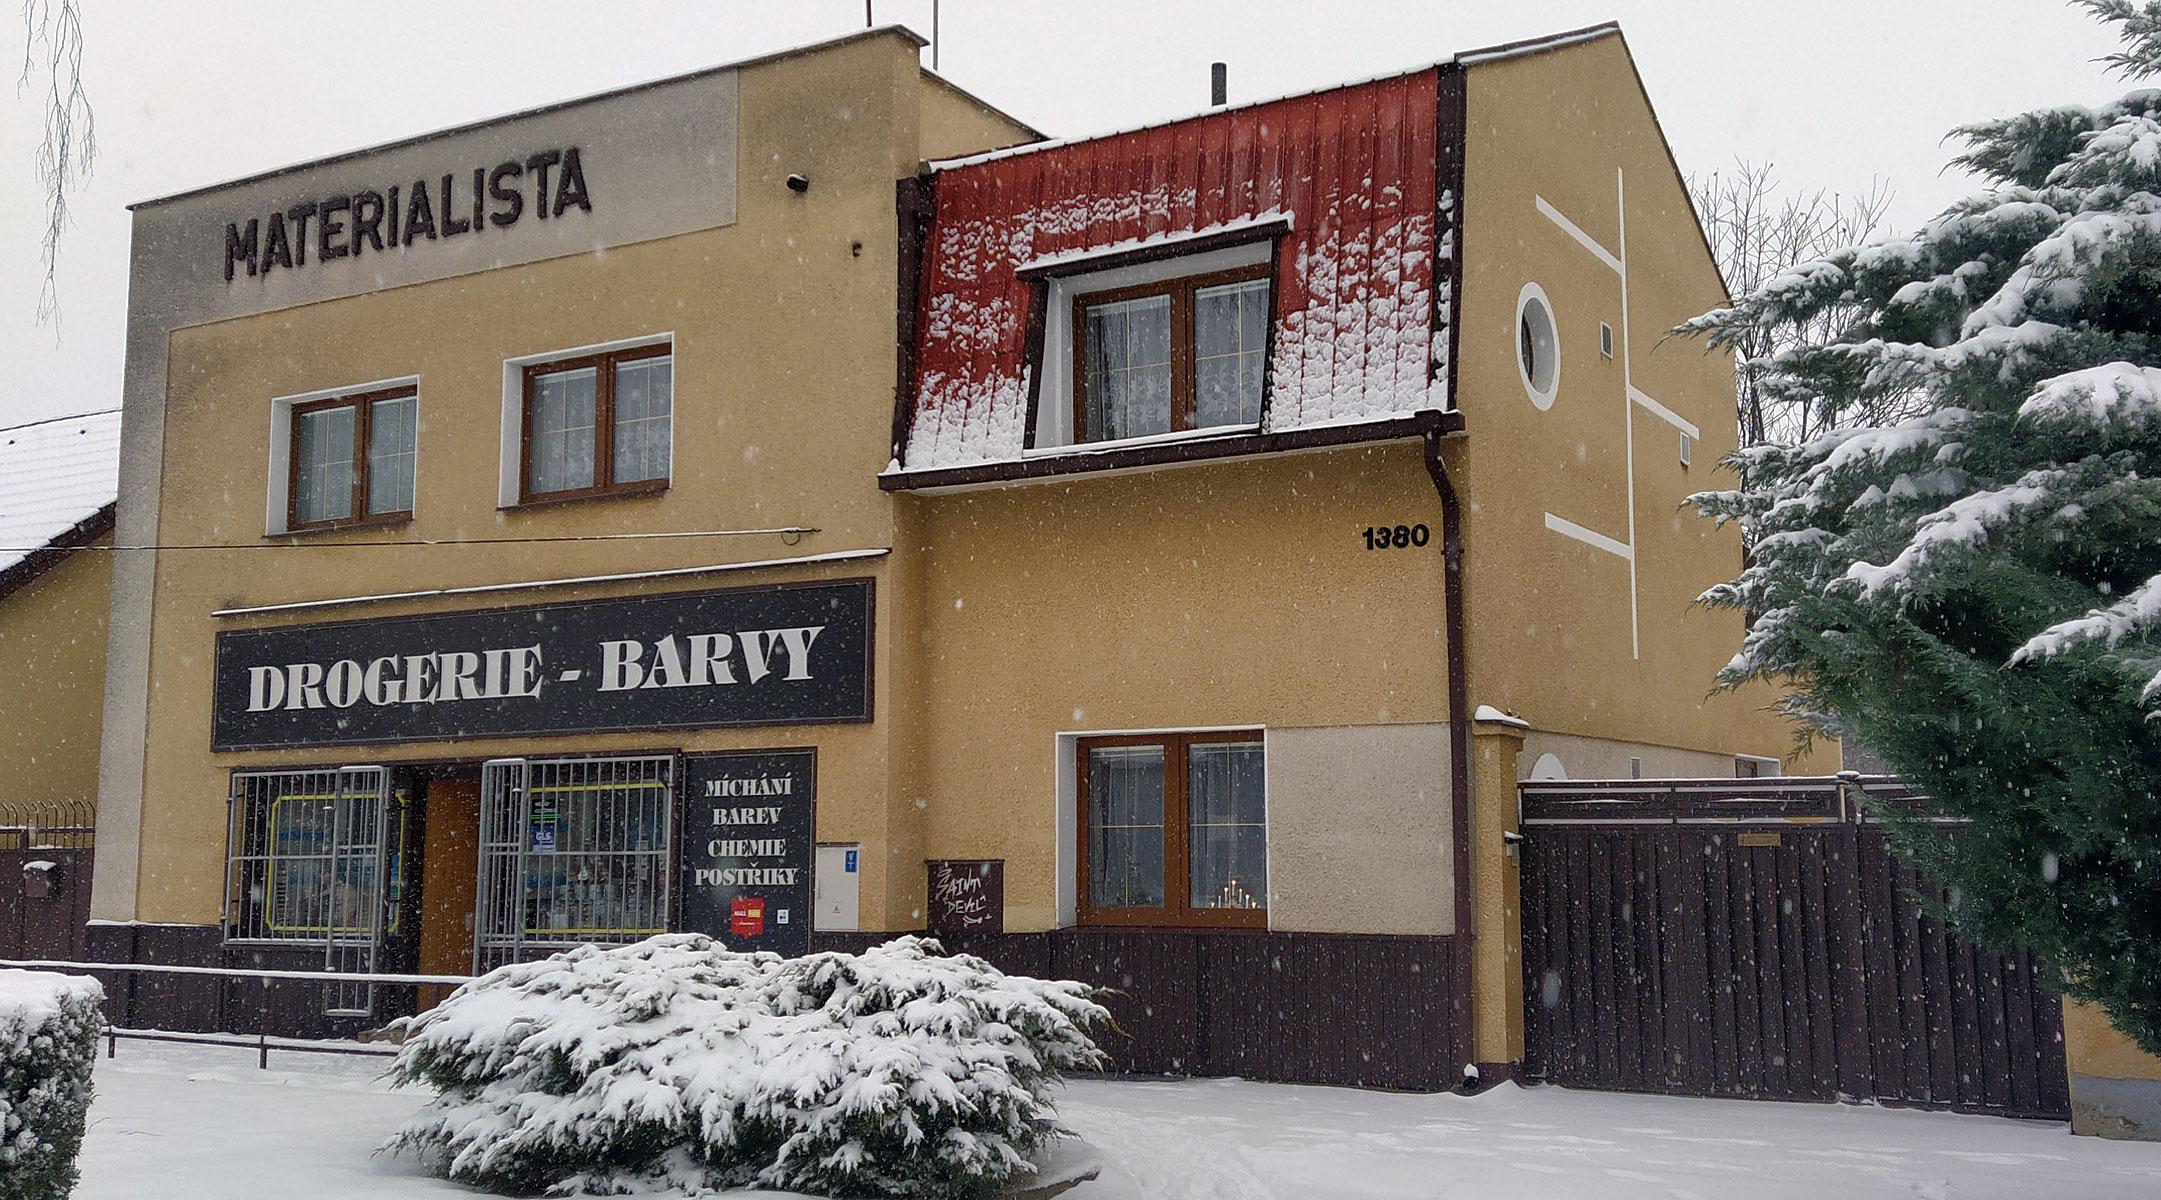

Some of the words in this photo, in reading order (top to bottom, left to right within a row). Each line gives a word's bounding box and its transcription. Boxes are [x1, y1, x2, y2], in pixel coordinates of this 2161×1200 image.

[224, 145, 592, 282] MATERIALISTA
[1362, 523, 1430, 550] 1380
[245, 643, 542, 712] DROGERIE
[597, 625, 826, 693] BARVY
[704, 772, 792, 797] MÍCHÁNÍ
[712, 807, 783, 825] BAREV
[707, 838, 787, 858] CHEMIE
[695, 861, 798, 886] POSTŘIKY
